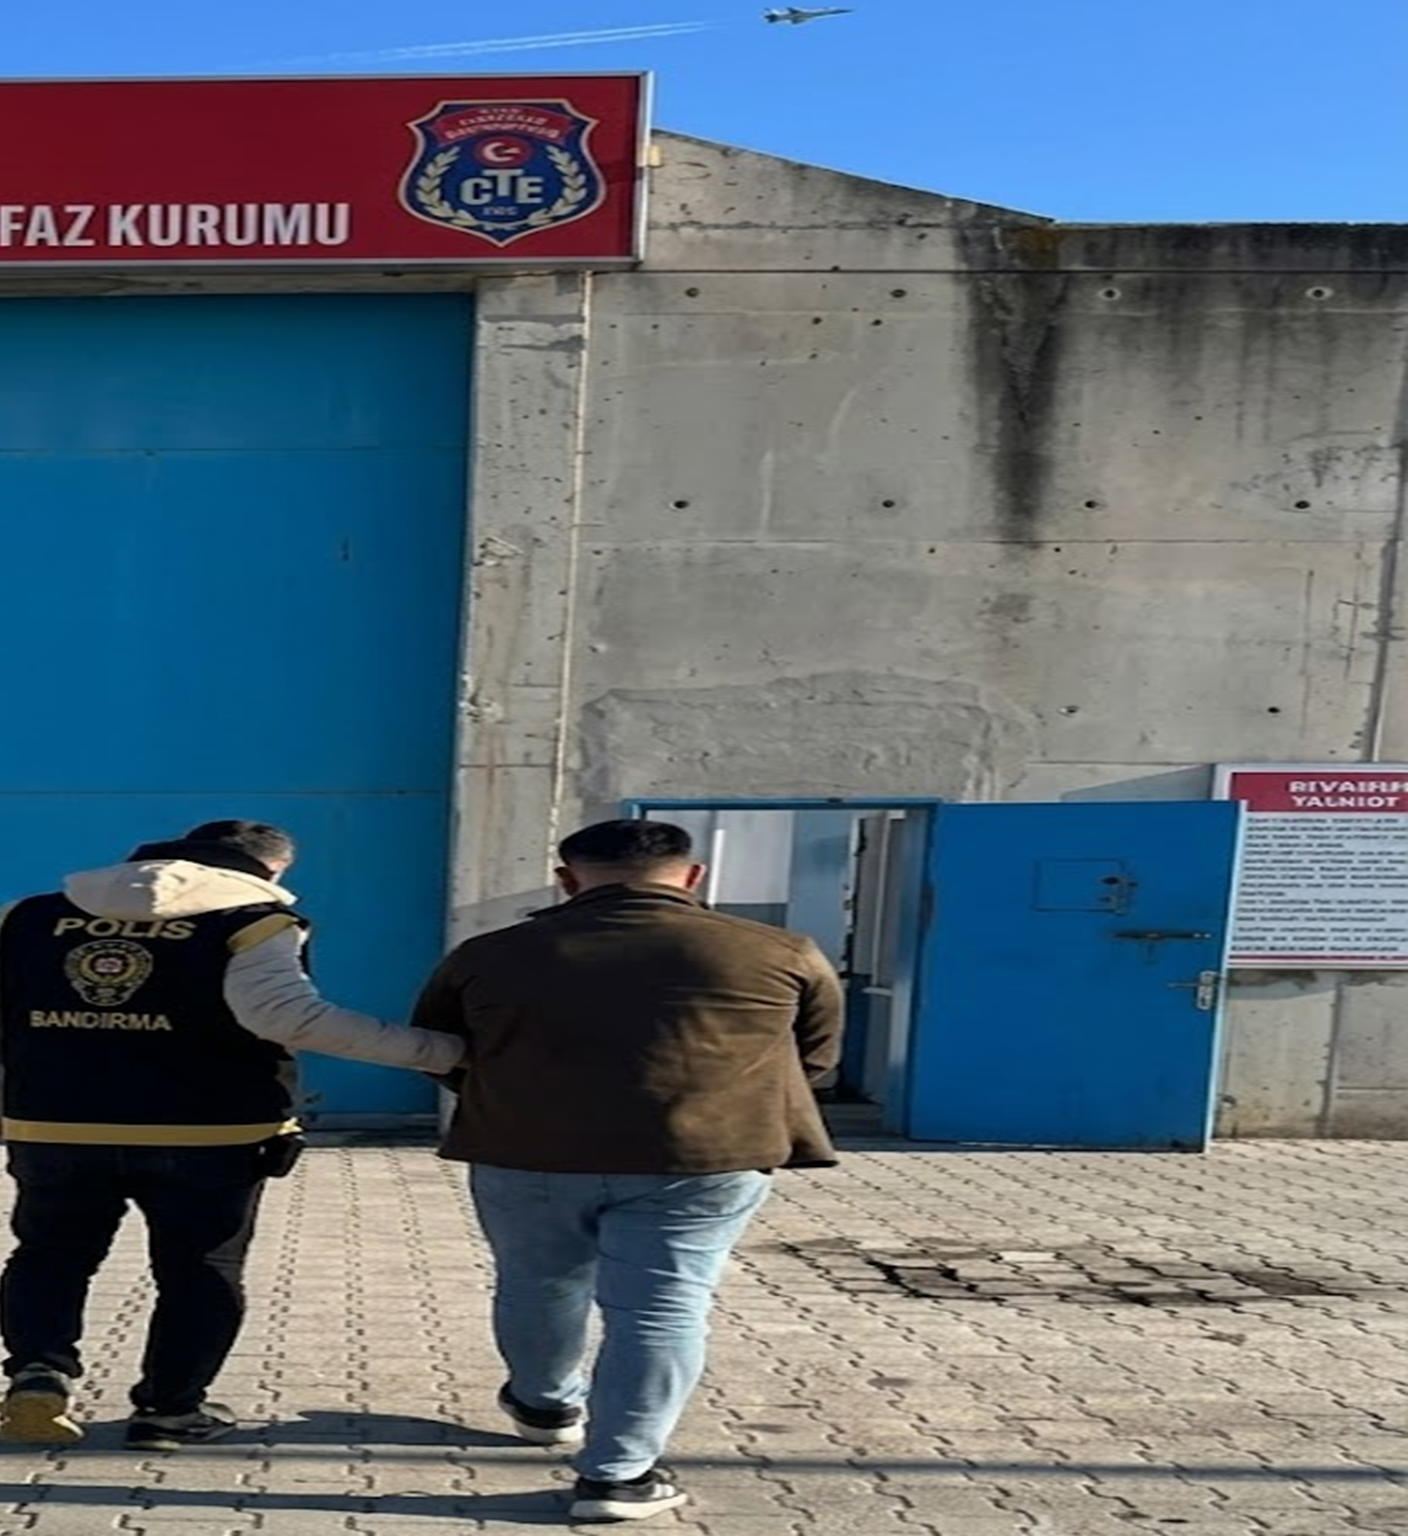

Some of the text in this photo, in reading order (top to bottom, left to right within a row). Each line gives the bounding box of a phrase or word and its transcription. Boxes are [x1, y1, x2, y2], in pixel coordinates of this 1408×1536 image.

[460, 168, 544, 206] CTE
[109, 203, 348, 246] KURUMU
[30, 1010, 173, 1031] BANDIRMA
